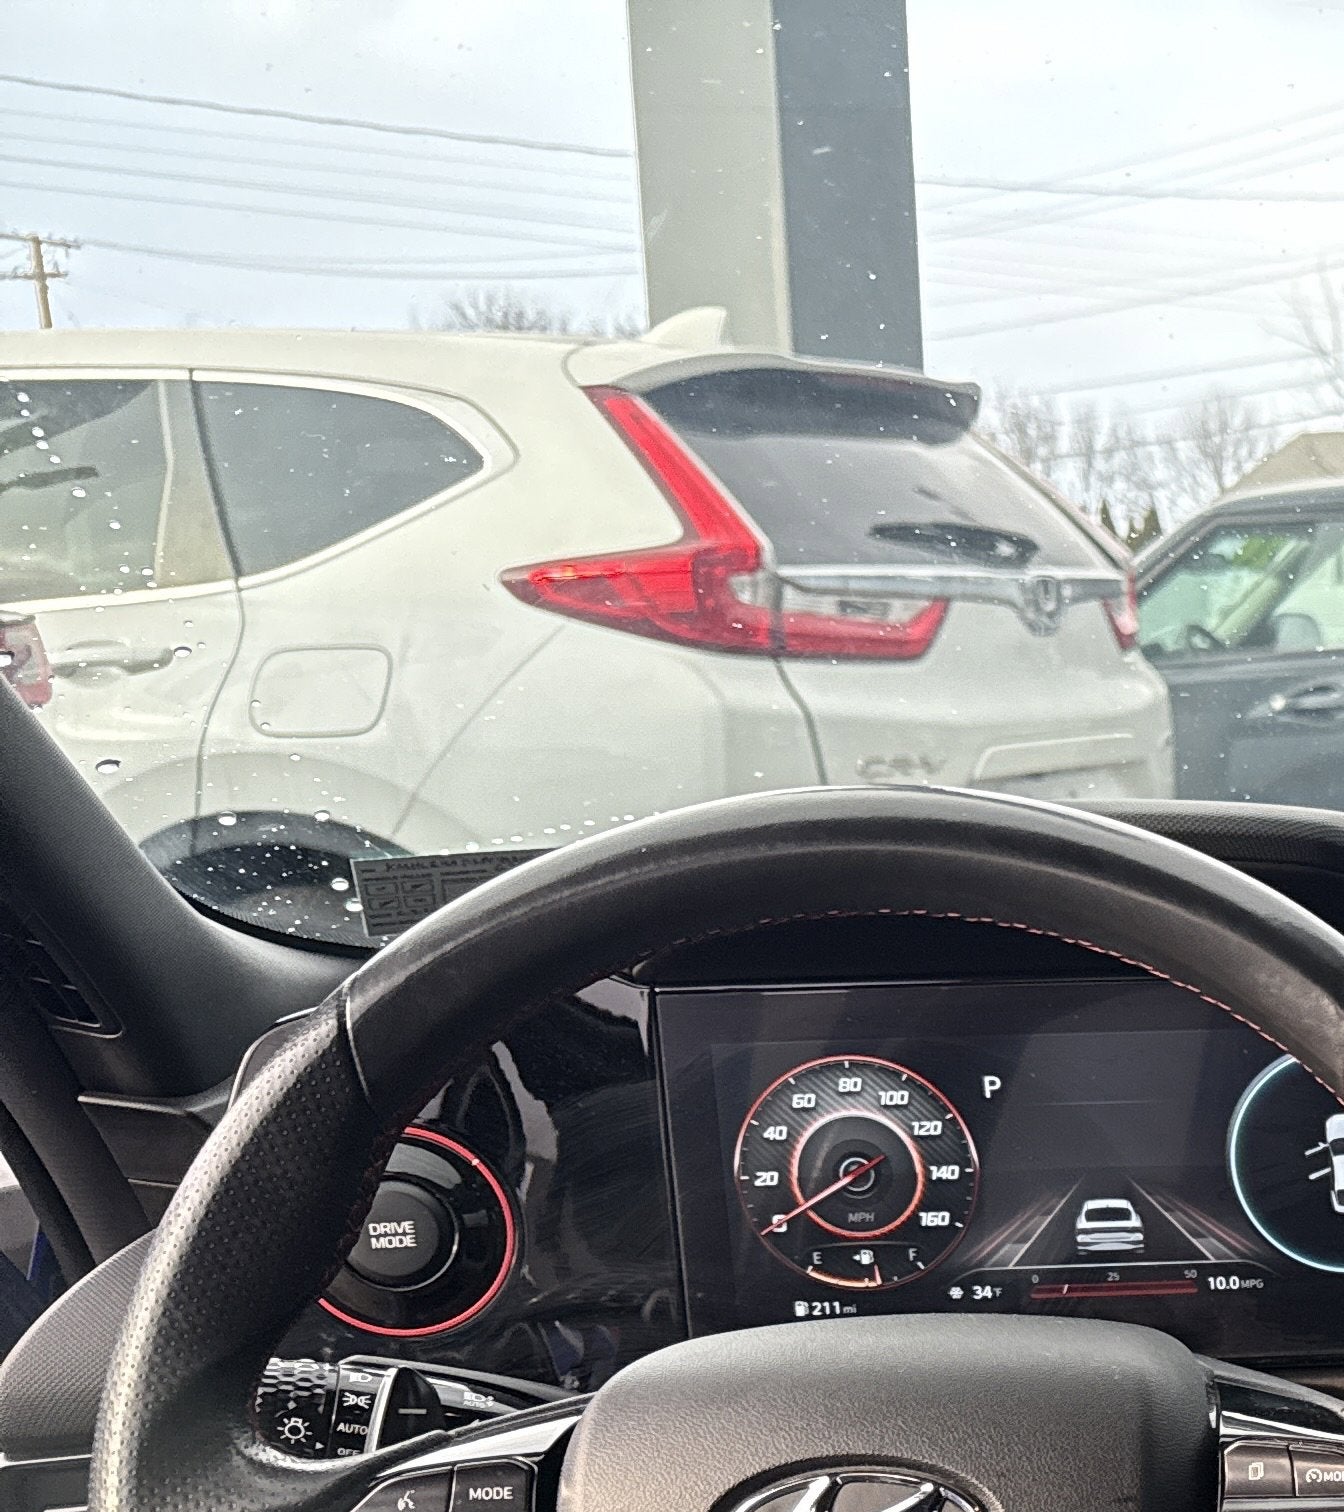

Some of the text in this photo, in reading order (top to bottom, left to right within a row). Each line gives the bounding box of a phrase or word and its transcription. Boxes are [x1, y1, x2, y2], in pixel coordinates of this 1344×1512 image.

[838, 1077, 862, 1093] 80
[983, 1075, 1001, 1098] P
[792, 1094, 816, 1109] 60
[878, 1091, 909, 1106] 100
[763, 1125, 787, 1140] 40
[911, 1120, 942, 1135] 120
[754, 1171, 779, 1187] 20
[929, 1166, 960, 1181] 140
[848, 1212, 875, 1223] MPH
[918, 1211, 950, 1226] 160
[368, 1220, 415, 1237] DRIVE
[371, 1234, 417, 1250] MODE
[813, 1252, 822, 1265] E
[909, 1248, 918, 1261] F
[1208, 1277, 1240, 1291] 10.0
[812, 1301, 841, 1315] 211
[336, 1422, 368, 1436] AUTO
[468, 1486, 514, 1501] MODE
